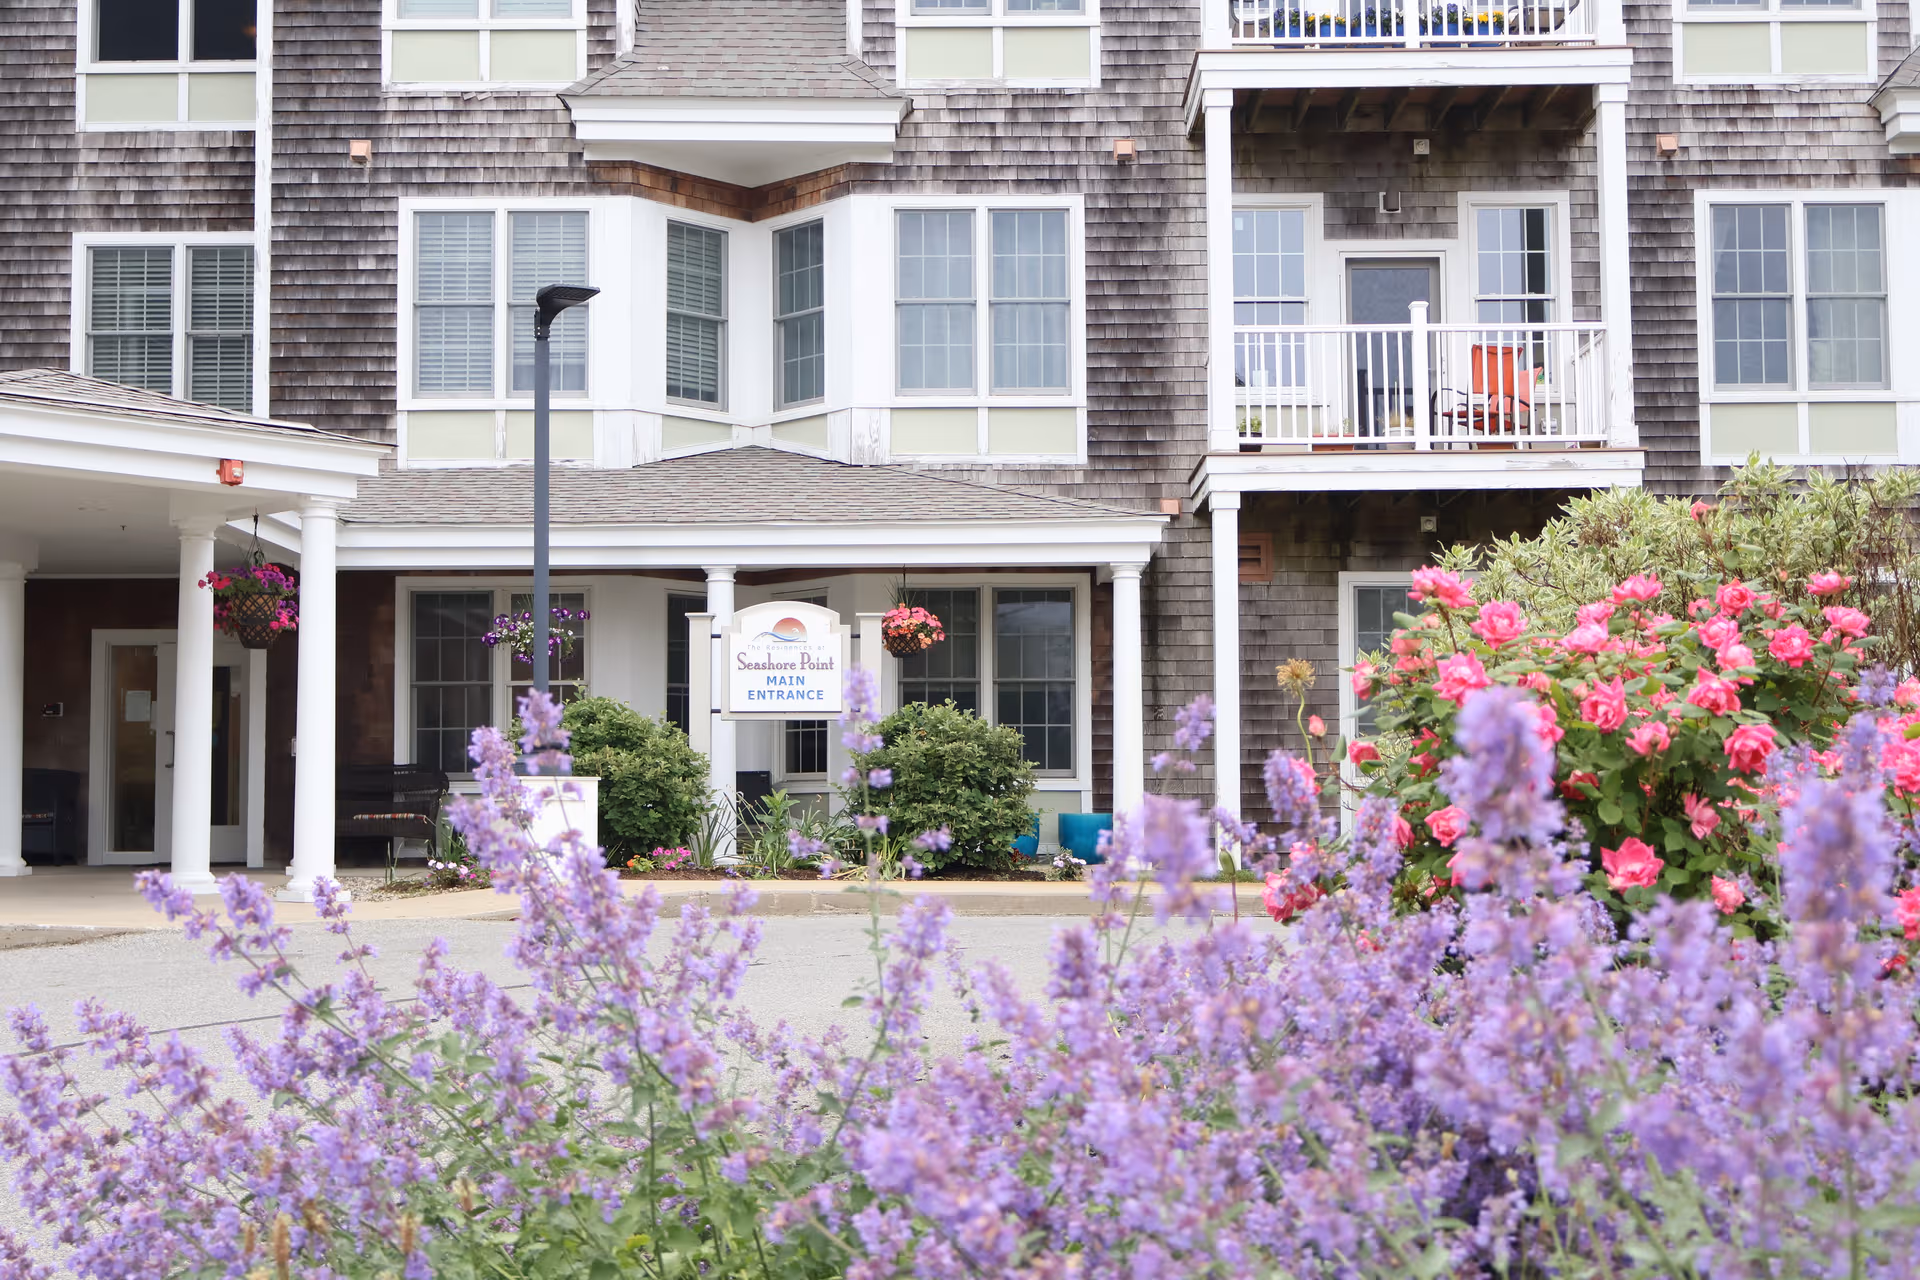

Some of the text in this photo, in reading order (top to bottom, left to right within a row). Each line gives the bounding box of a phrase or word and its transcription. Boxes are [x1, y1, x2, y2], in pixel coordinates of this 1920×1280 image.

[736, 651, 835, 670] Seashore Point
[766, 675, 805, 686] MAIN
[747, 689, 824, 700] ENTRANCE
